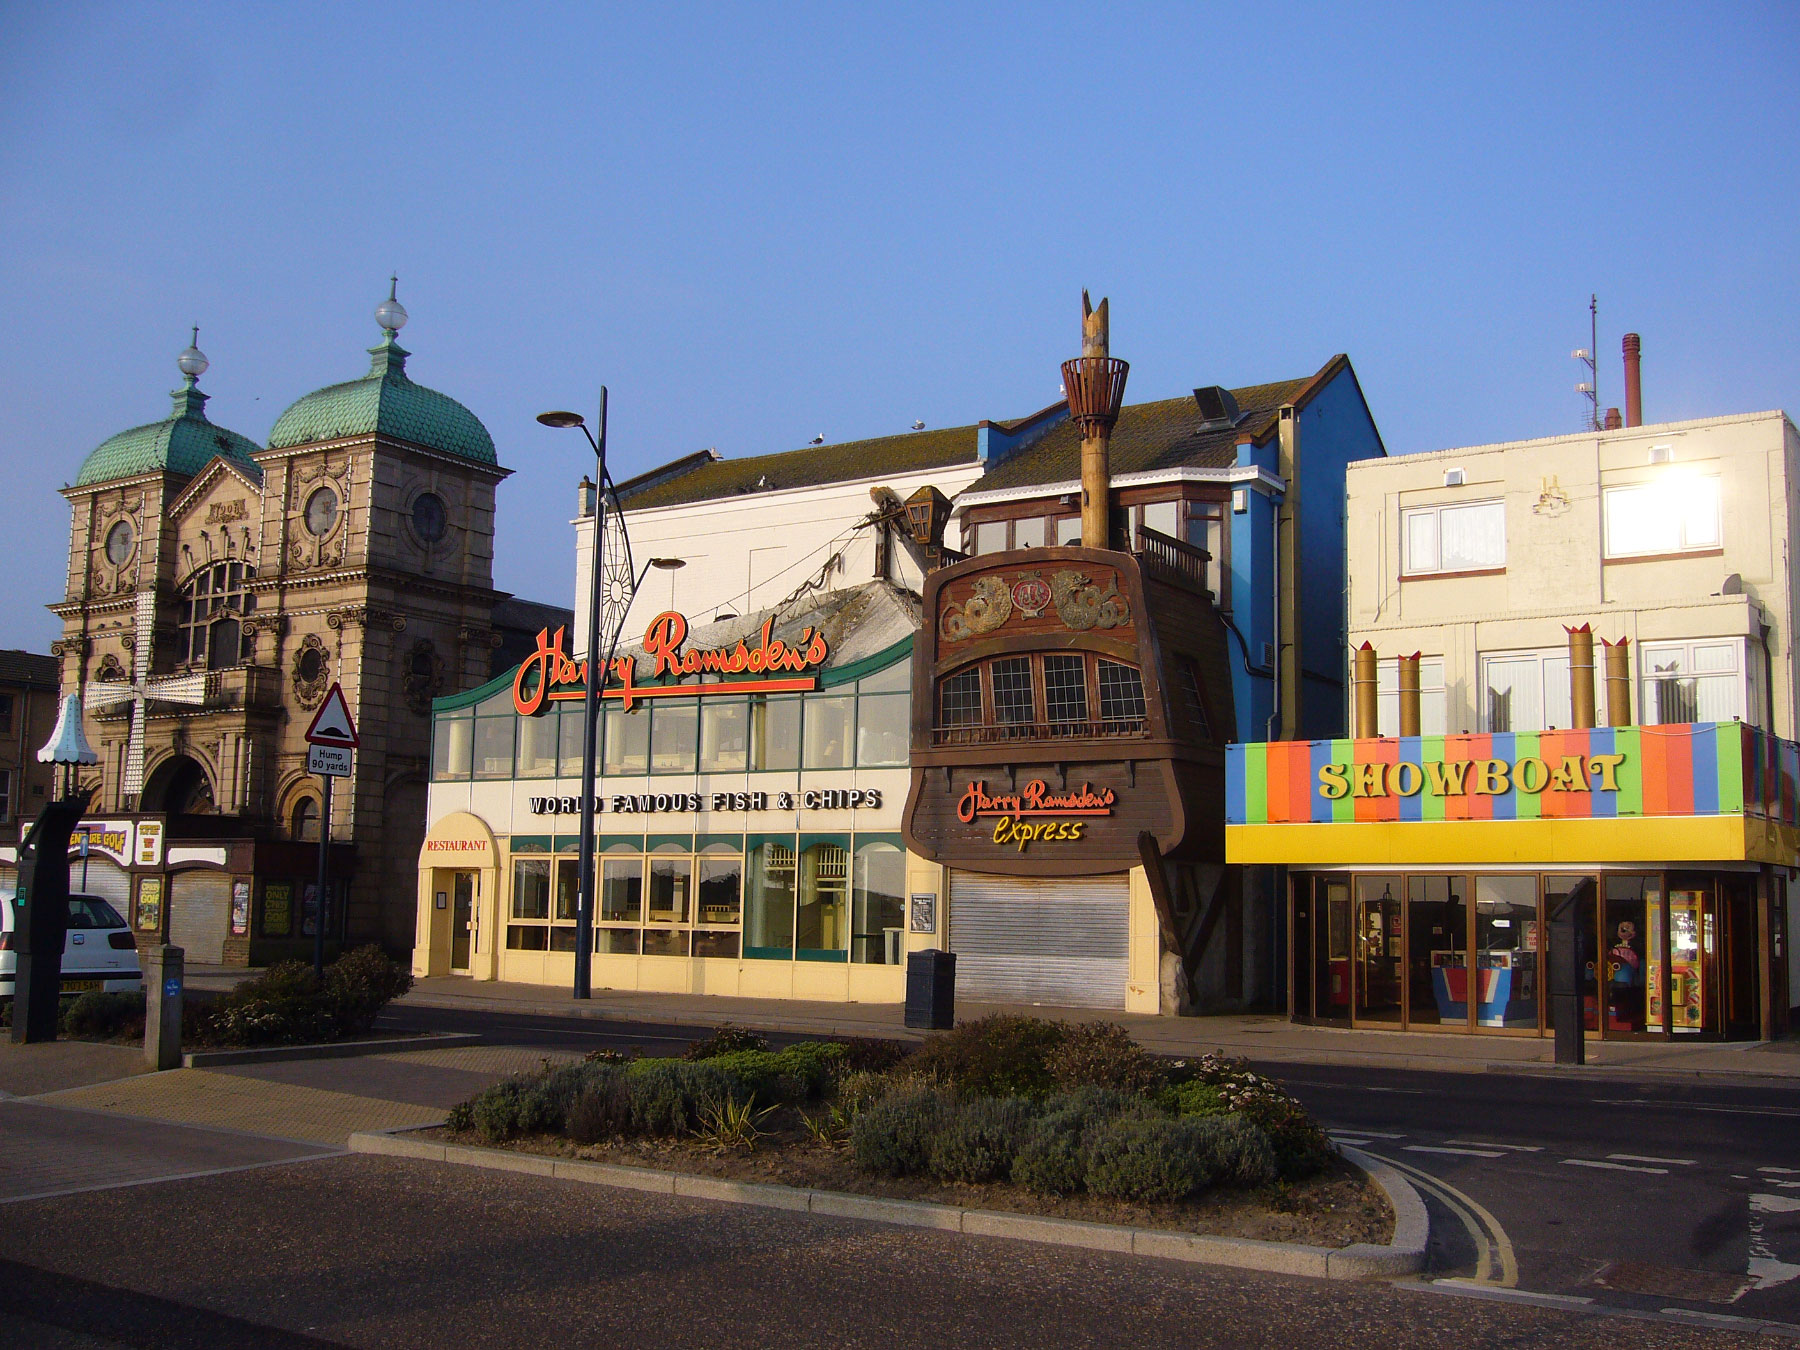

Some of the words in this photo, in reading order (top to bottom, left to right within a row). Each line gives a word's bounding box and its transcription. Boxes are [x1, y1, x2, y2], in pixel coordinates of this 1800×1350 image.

[643, 611, 829, 679] Ramsden's
[312, 759, 324, 769] 90
[326, 762, 348, 772] yards
[319, 749, 343, 761] Hump
[1318, 753, 1625, 800] SHOWBOAT
[529, 797, 602, 815] WORL
[612, 794, 701, 813] FAMOUS
[712, 792, 763, 811] FISH
[777, 792, 790, 808] &
[804, 789, 882, 809] CHIPS
[957, 781, 1021, 822] Harry
[1024, 779, 1114, 810] Ramsden's
[103, 833, 125, 852] GOLF
[427, 840, 488, 851] RESTAURANT
